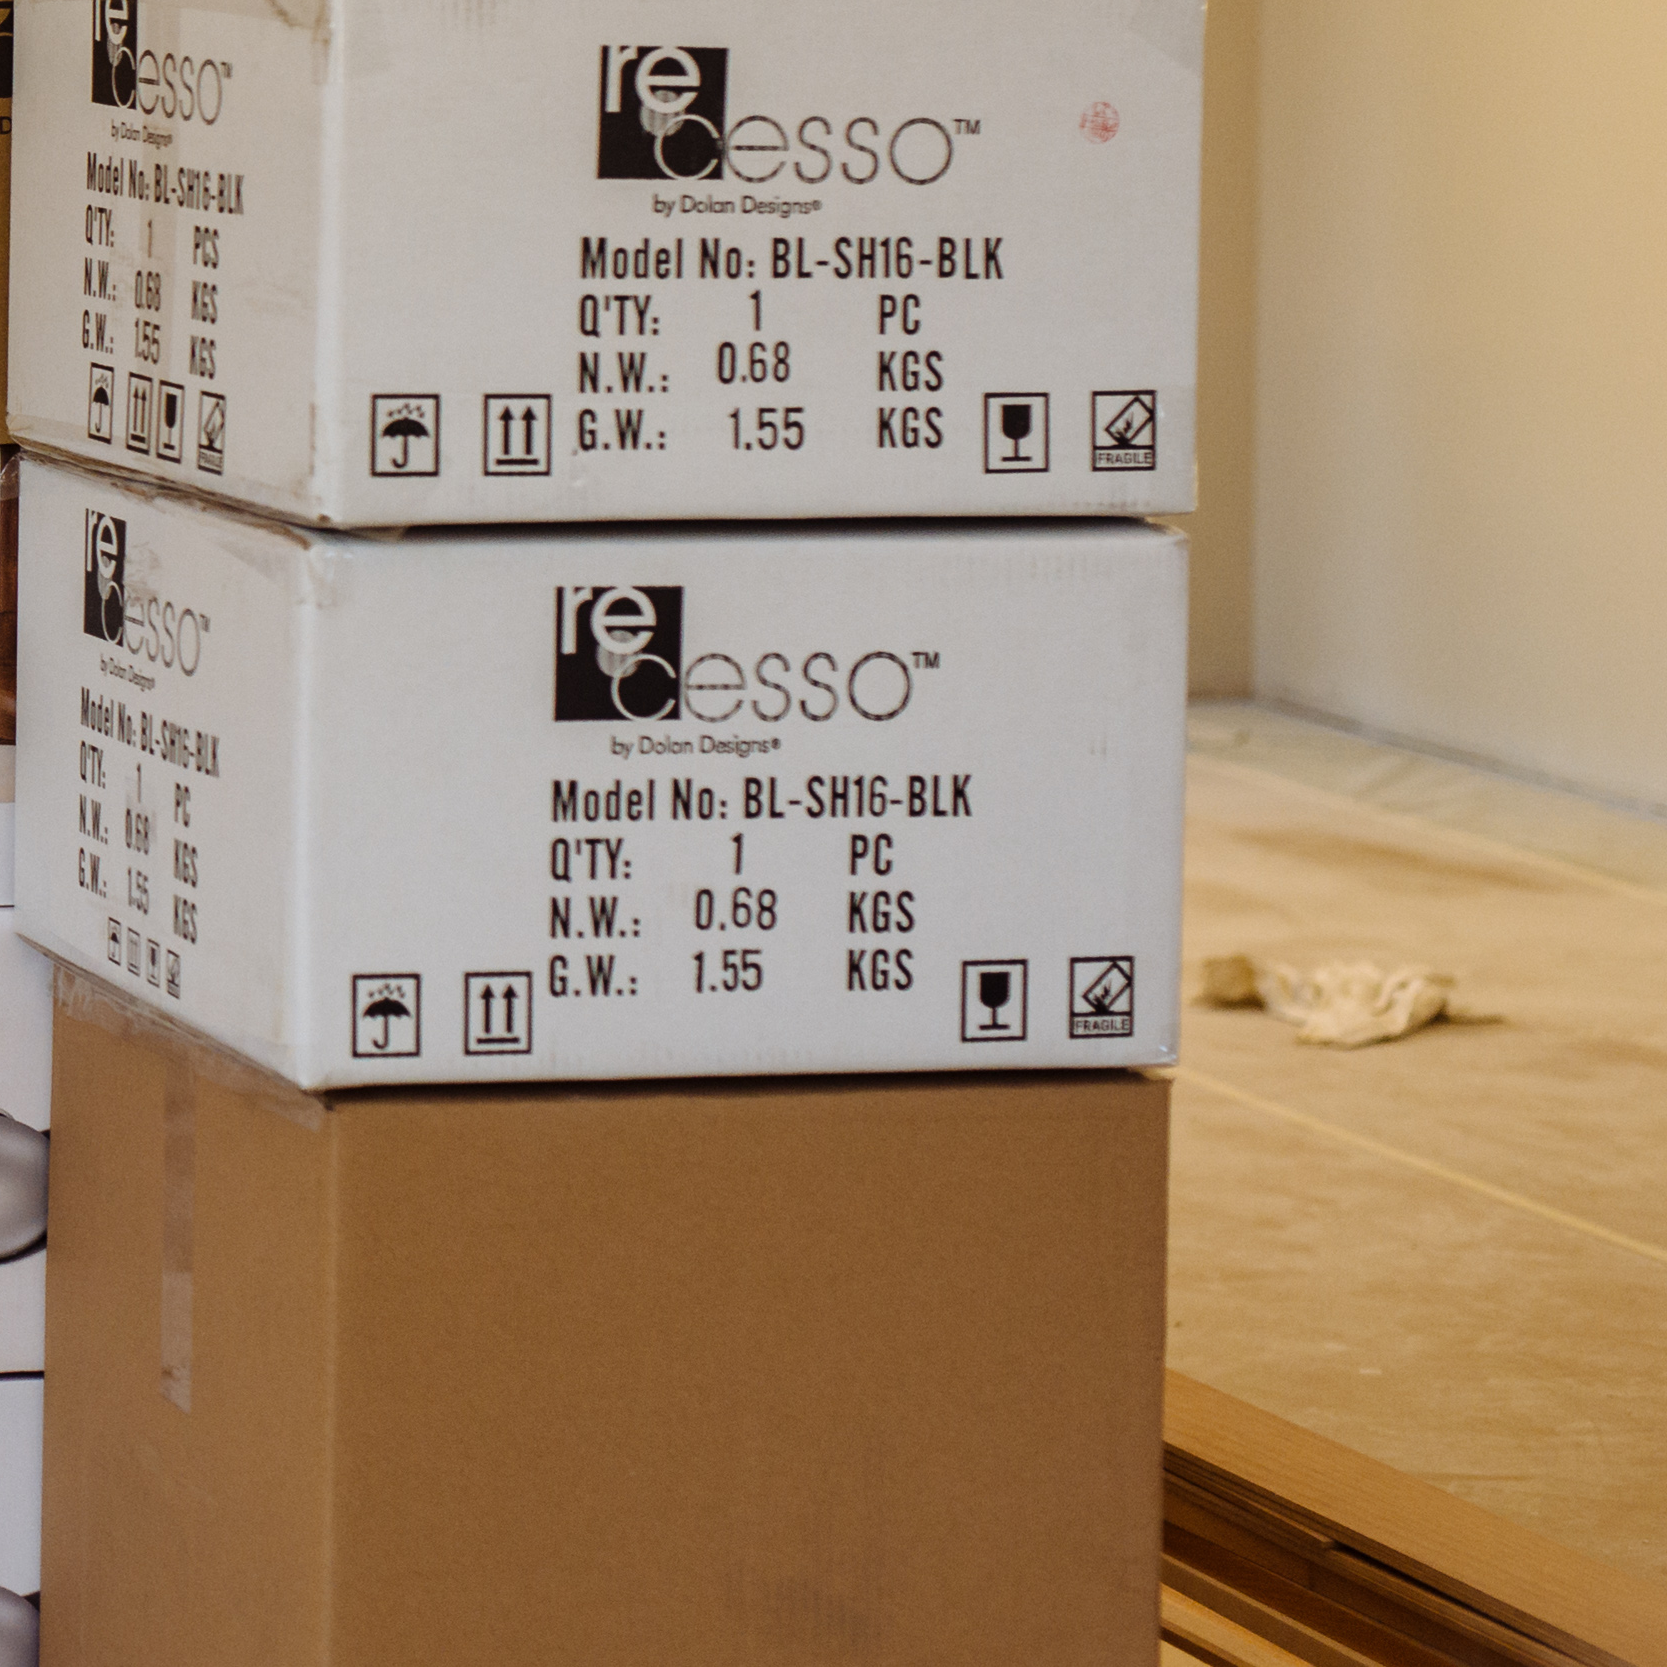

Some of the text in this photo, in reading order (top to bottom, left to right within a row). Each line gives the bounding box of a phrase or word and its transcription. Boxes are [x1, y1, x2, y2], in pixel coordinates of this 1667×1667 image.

[87, 151, 124, 197] Model
[129, 158, 149, 202] No:
[652, 194, 675, 216] by
[680, 194, 735, 214] Dolan
[85, 204, 220, 269] Q'TY: 1 PCS
[580, 236, 1004, 280] Model No: BL-SH16-BLK
[84, 257, 217, 325] N.W.: 0.68 KGS
[579, 290, 922, 337] Q'TY: 1 PC
[82, 309, 216, 380] G.W.: 1.55 KGS
[578, 342, 945, 394] N.W.: 0.68 KGS
[578, 407, 945, 451] G.W.: 1.55 KGS
[1097, 451, 1153, 466] FRAGILE
[80, 686, 113, 738] Model
[610, 735, 633, 759] by
[639, 735, 693, 755] Dolan
[80, 740, 191, 828] Q'TY: 1 PC
[551, 774, 972, 823] Model No: BL-SH16-BLK
[79, 794, 108, 845] N.W.:
[79, 847, 106, 898] G.W.:
[551, 833, 893, 881] Q'TY: 1 PC
[550, 887, 915, 938] N.W.: 0.68 KGS
[549, 948, 914, 997] G.W.: 1.55 KGS
[1075, 1018, 1130, 1033] FRAGILE
